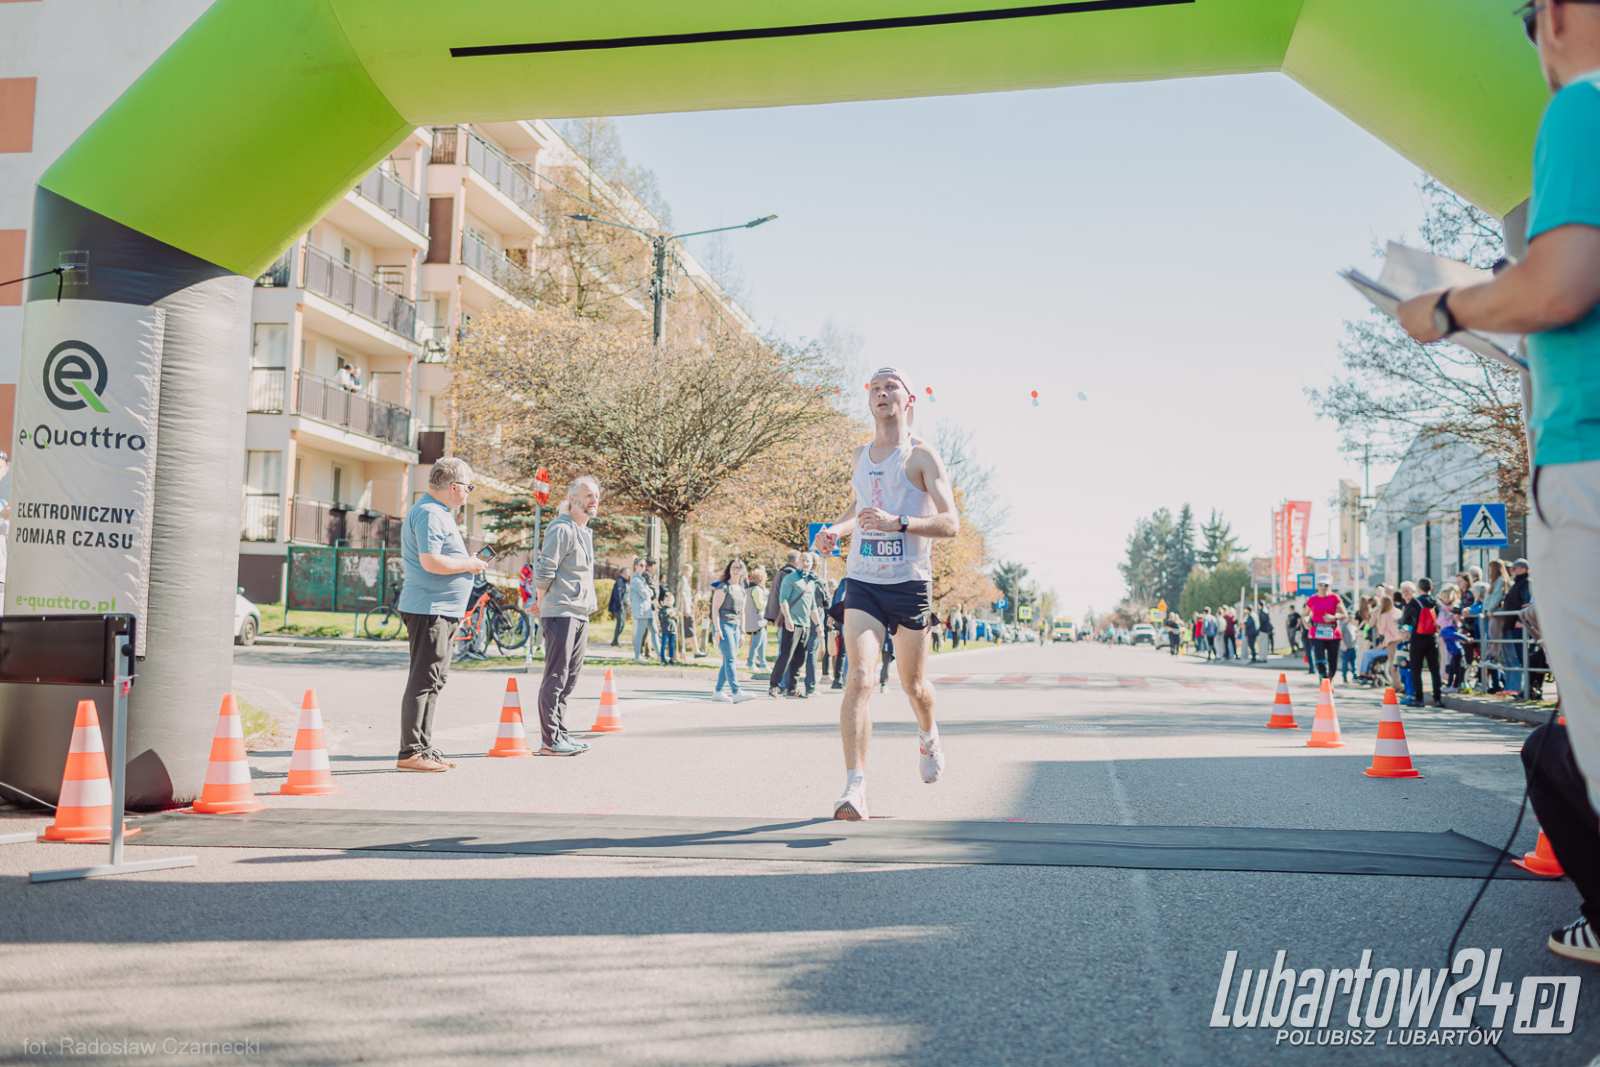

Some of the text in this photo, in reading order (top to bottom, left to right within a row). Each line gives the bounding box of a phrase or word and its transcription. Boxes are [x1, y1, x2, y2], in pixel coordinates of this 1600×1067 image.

[17, 502, 135, 524] ELEKTRONICZNY
[16, 527, 133, 549] POMIAR CZASU
[877, 541, 901, 555] 066
[16, 594, 117, 612] e-quattro.pl
